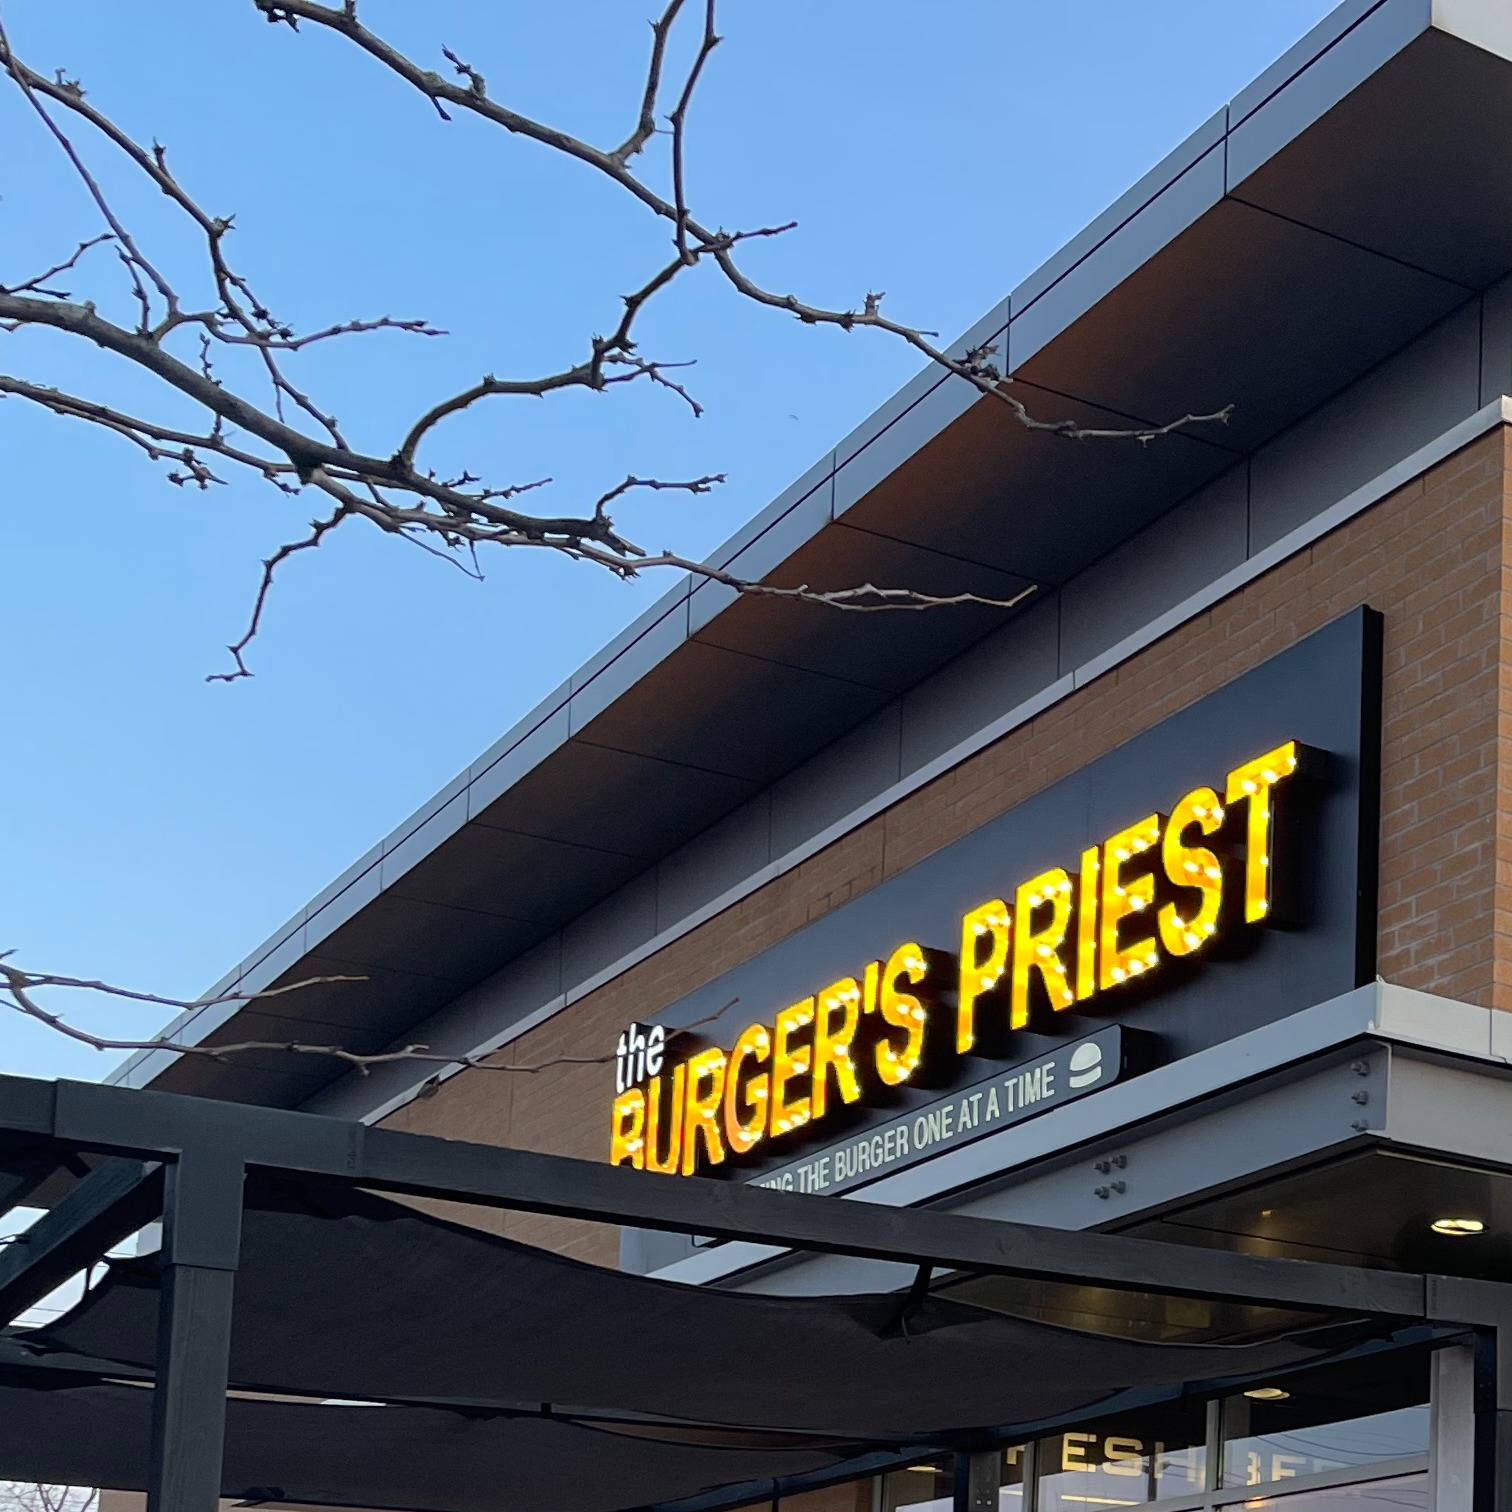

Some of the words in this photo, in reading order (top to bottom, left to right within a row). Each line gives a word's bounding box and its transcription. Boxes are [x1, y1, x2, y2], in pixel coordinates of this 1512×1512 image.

[610, 942, 926, 1177] BURGER'S
[957, 740, 1297, 1054] PRIEST
[616, 1022, 665, 1094] the
[797, 1156, 830, 1194] THE
[834, 1124, 909, 1183] BURGER
[913, 1105, 954, 1150] ONE
[957, 1092, 983, 1133] AT
[985, 1087, 1000, 1122] A
[1004, 1061, 1056, 1113] TIME
